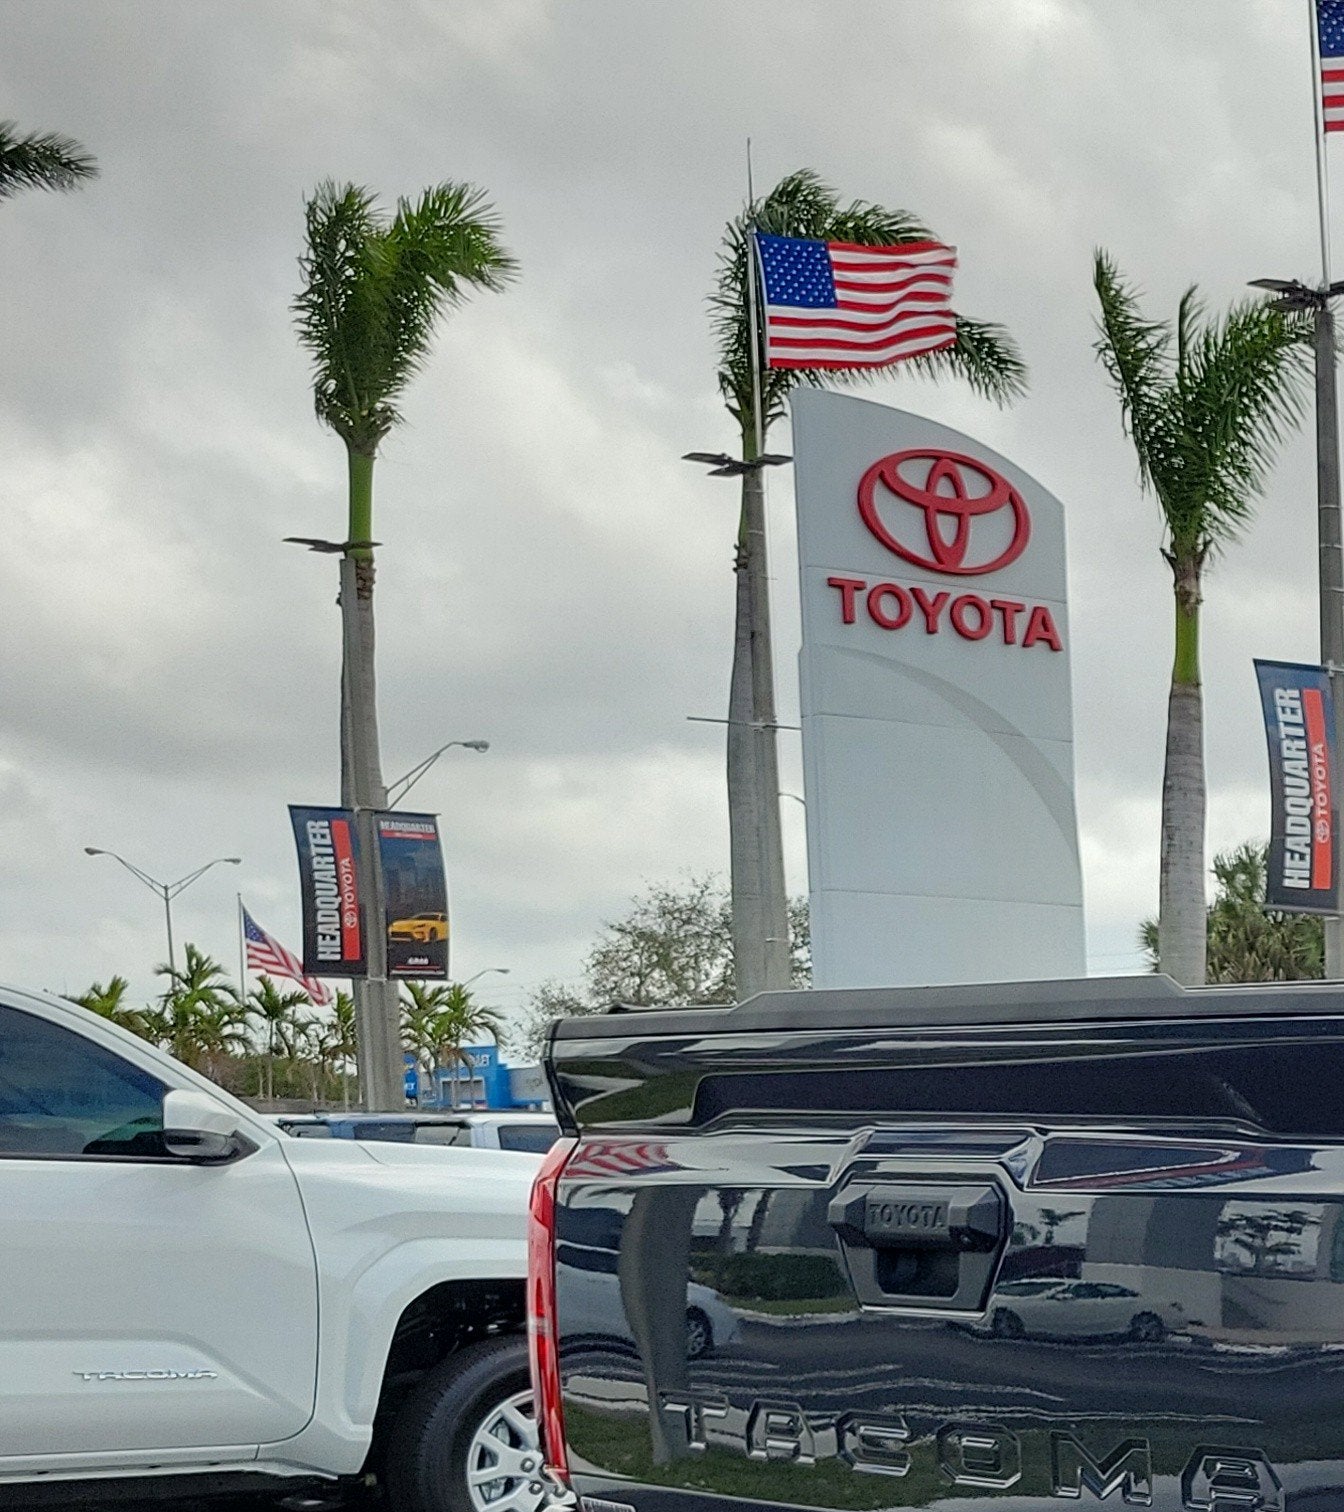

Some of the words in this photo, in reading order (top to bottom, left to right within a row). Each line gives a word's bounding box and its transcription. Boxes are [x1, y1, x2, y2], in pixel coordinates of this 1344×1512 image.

[827, 577, 1064, 652] TOYOTA
[1273, 687, 1313, 890] HEADQUARTER
[1313, 743, 1330, 818] TOYOTA
[306, 819, 341, 962] HEADQUARTER
[342, 857, 356, 914] TOYOTA
[868, 1203, 946, 1229] TOYOTA
[73, 1369, 218, 1380] TACOMA
